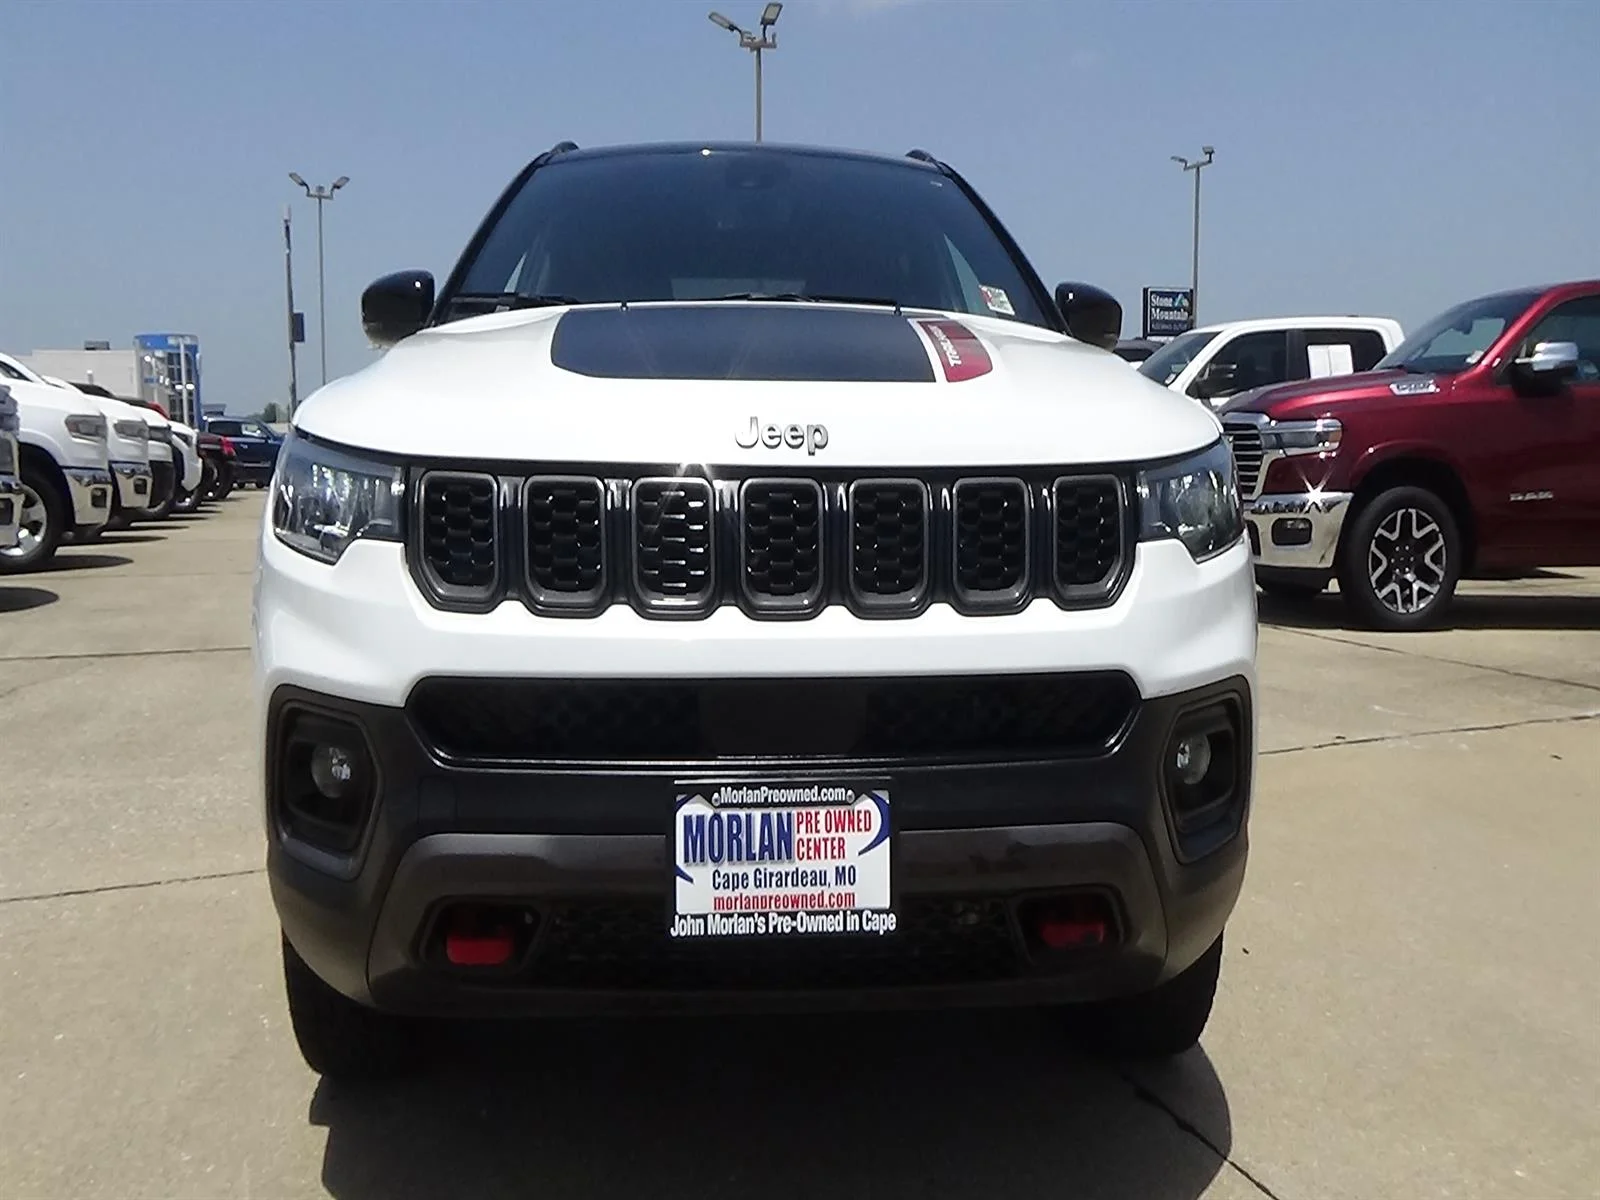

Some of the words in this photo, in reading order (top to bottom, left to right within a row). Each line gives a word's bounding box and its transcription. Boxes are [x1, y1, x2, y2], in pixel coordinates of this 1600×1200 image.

[735, 416, 829, 456] Jeep
[720, 785, 846, 804] MorlanPreowned.com
[796, 811, 823, 834] PRE
[825, 809, 872, 833] OWNED
[683, 811, 793, 864] MORLAN
[796, 837, 846, 860] CENTER
[712, 869, 749, 891] Cape
[753, 867, 831, 889] Girardeau,
[834, 865, 857, 886] MO
[713, 890, 856, 911] morlanpreowned.com
[670, 915, 706, 938] John
[707, 913, 766, 936] Morlan's
[768, 911, 846, 934] Pre-Owned
[846, 911, 860, 932] in
[862, 911, 897, 935] Cape
